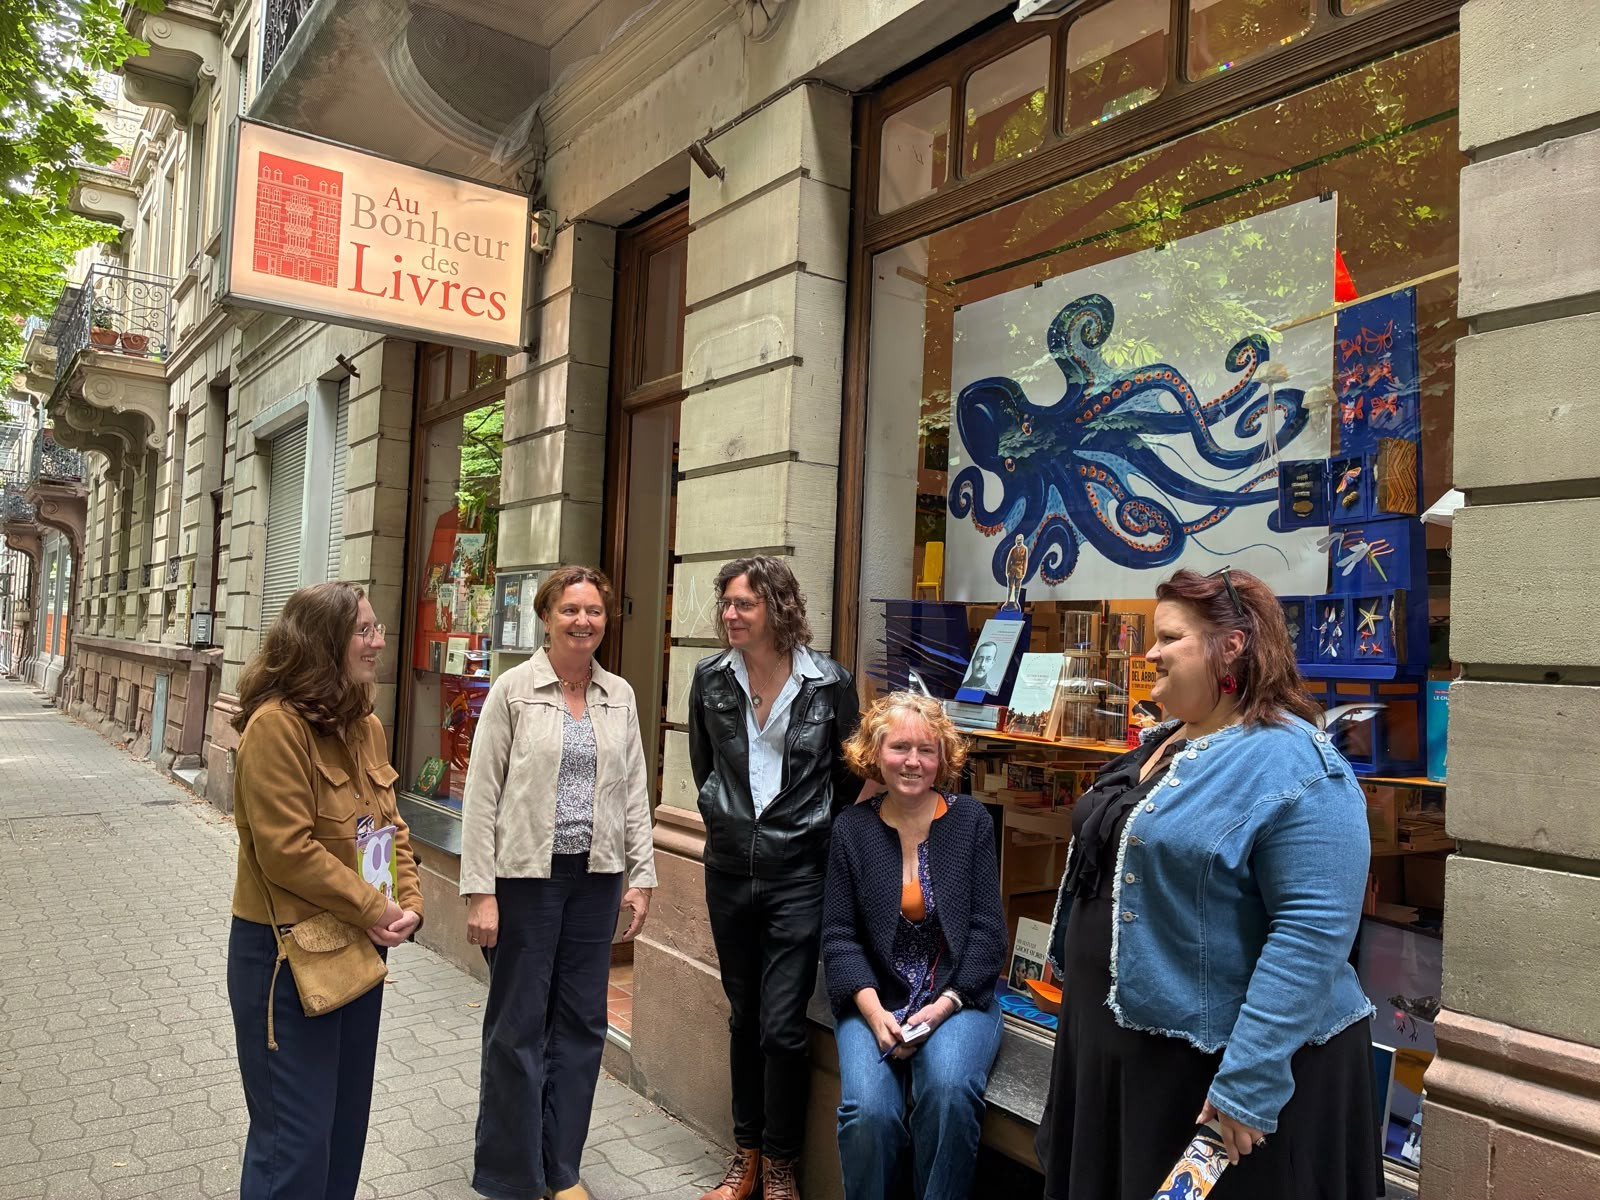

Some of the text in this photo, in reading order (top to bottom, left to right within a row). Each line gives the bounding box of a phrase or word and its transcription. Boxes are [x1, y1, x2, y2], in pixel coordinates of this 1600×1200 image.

[384, 186, 420, 215] Au
[350, 192, 510, 262] Bonheur
[421, 247, 460, 276] des
[347, 241, 507, 321] Livres
[1132, 671, 1140, 681] DEL
